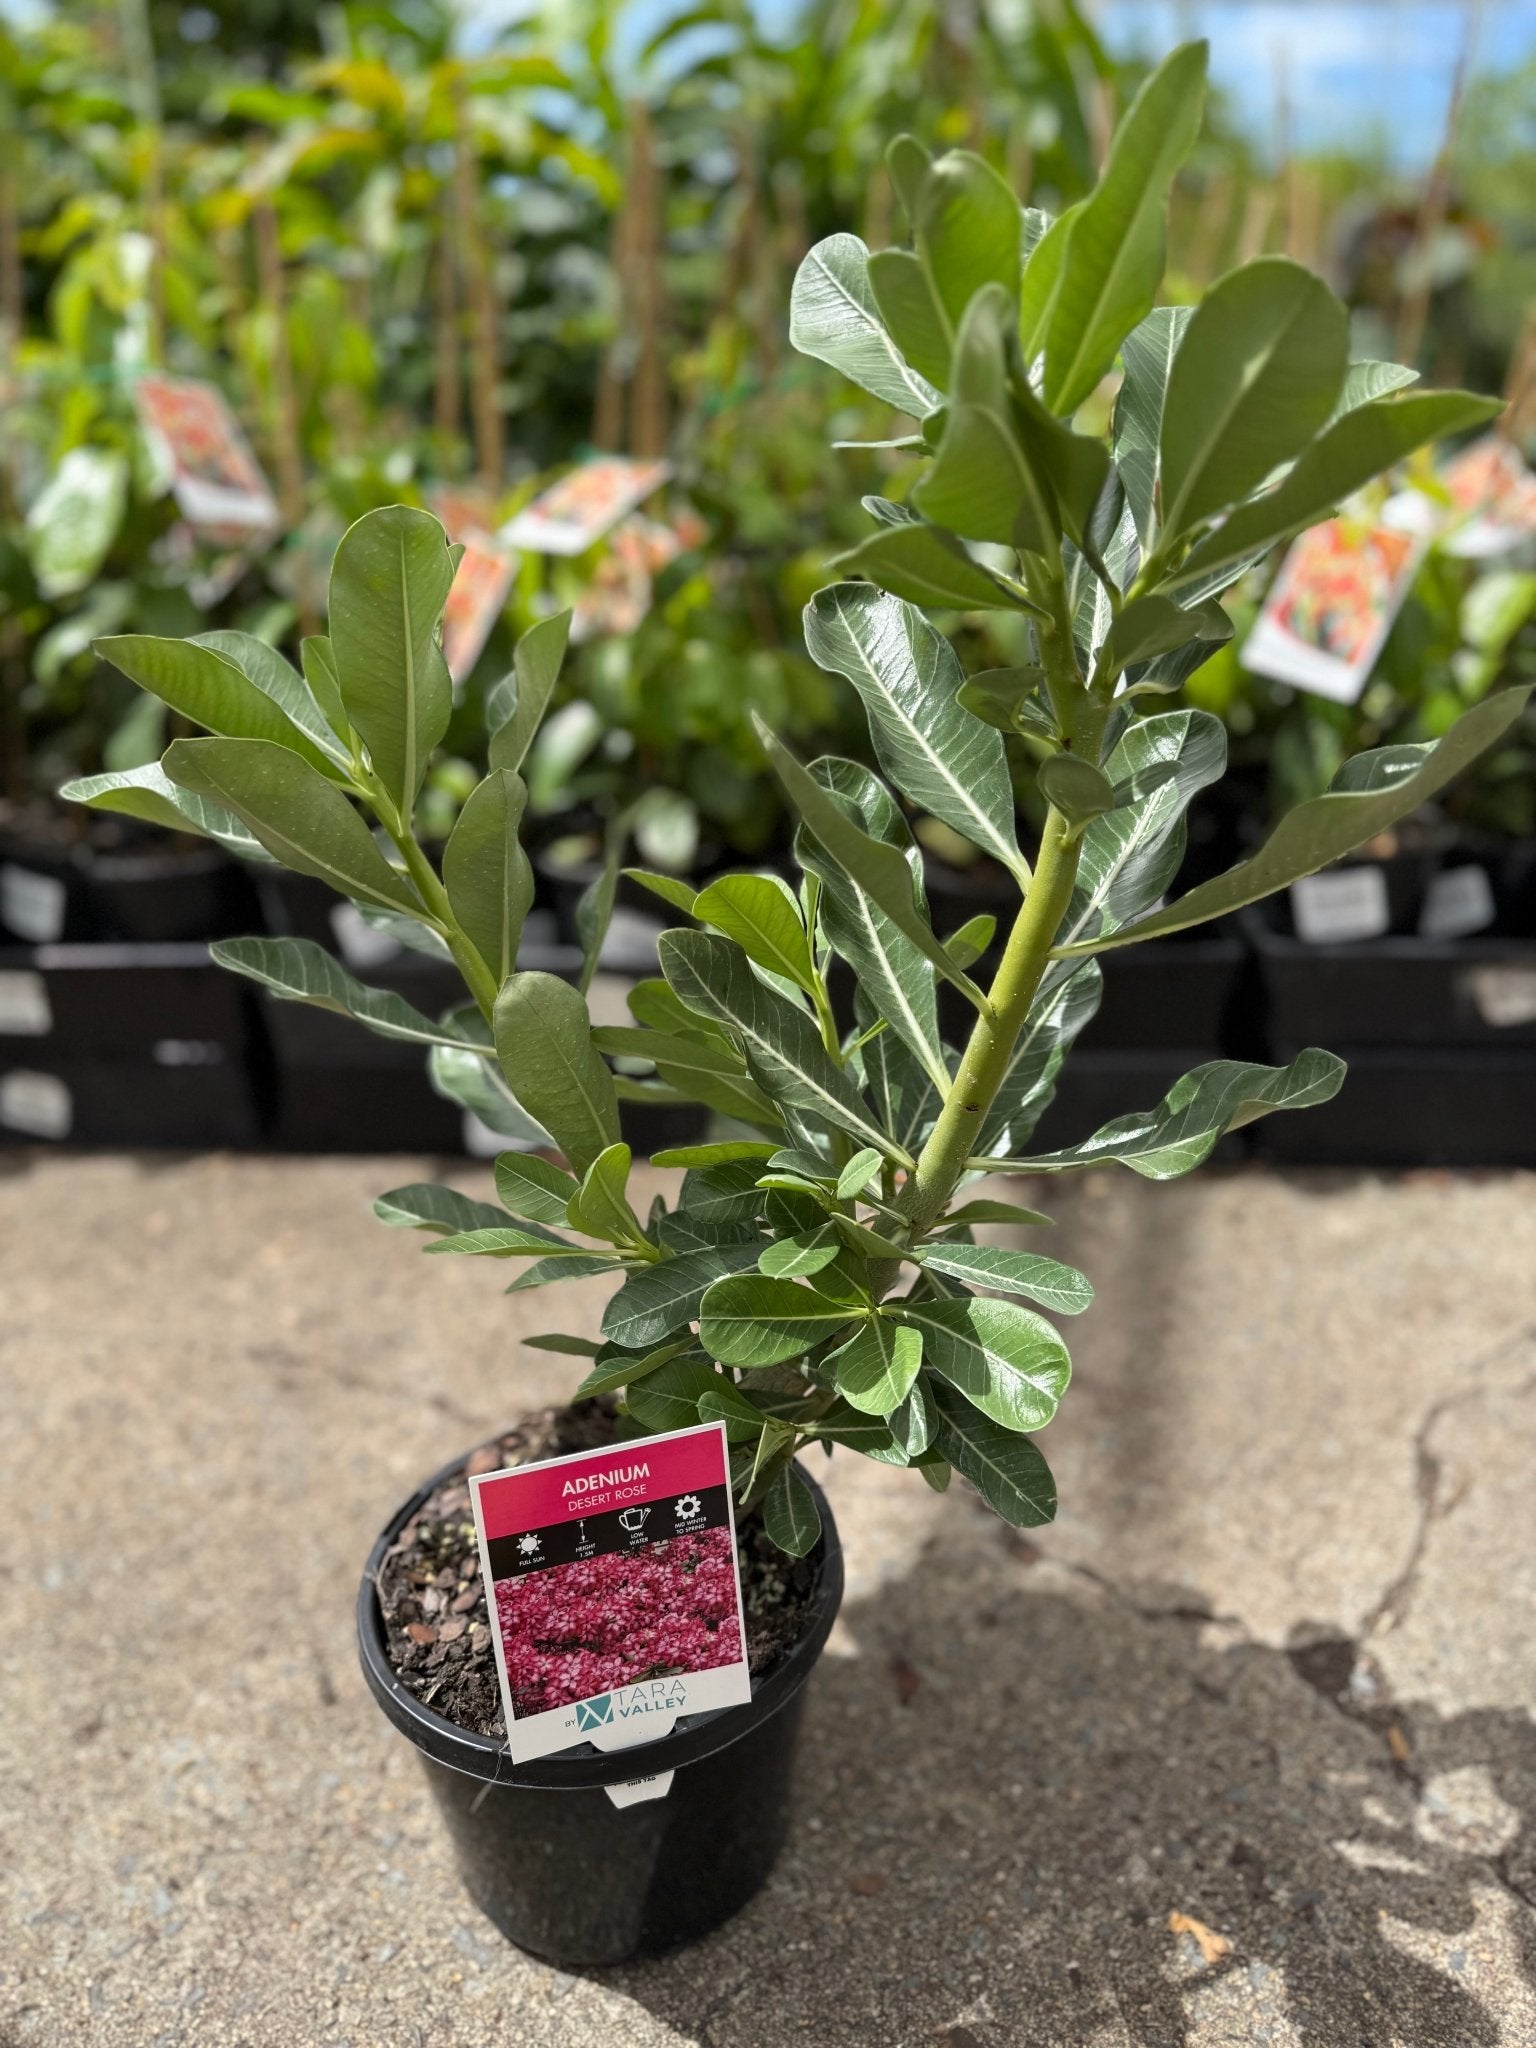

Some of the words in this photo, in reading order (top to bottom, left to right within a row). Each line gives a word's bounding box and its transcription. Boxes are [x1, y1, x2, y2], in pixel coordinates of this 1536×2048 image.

[561, 1463, 650, 1497] ADENIUM
[568, 1492, 611, 1511] DESERT
[615, 1484, 647, 1500] ROSE
[686, 1516, 707, 1526] WINTER
[685, 1523, 705, 1533] SPRING
[630, 1531, 644, 1539] LOW
[629, 1537, 649, 1546] WATER
[575, 1542, 596, 1553] HEIGHT
[519, 1559, 532, 1567] FULL
[533, 1555, 546, 1564] SUN
[614, 1679, 687, 1706] TARA
[619, 1695, 687, 1718] VALLEY
[564, 1719, 576, 1728] BY
[627, 1780, 642, 1788] THIS
